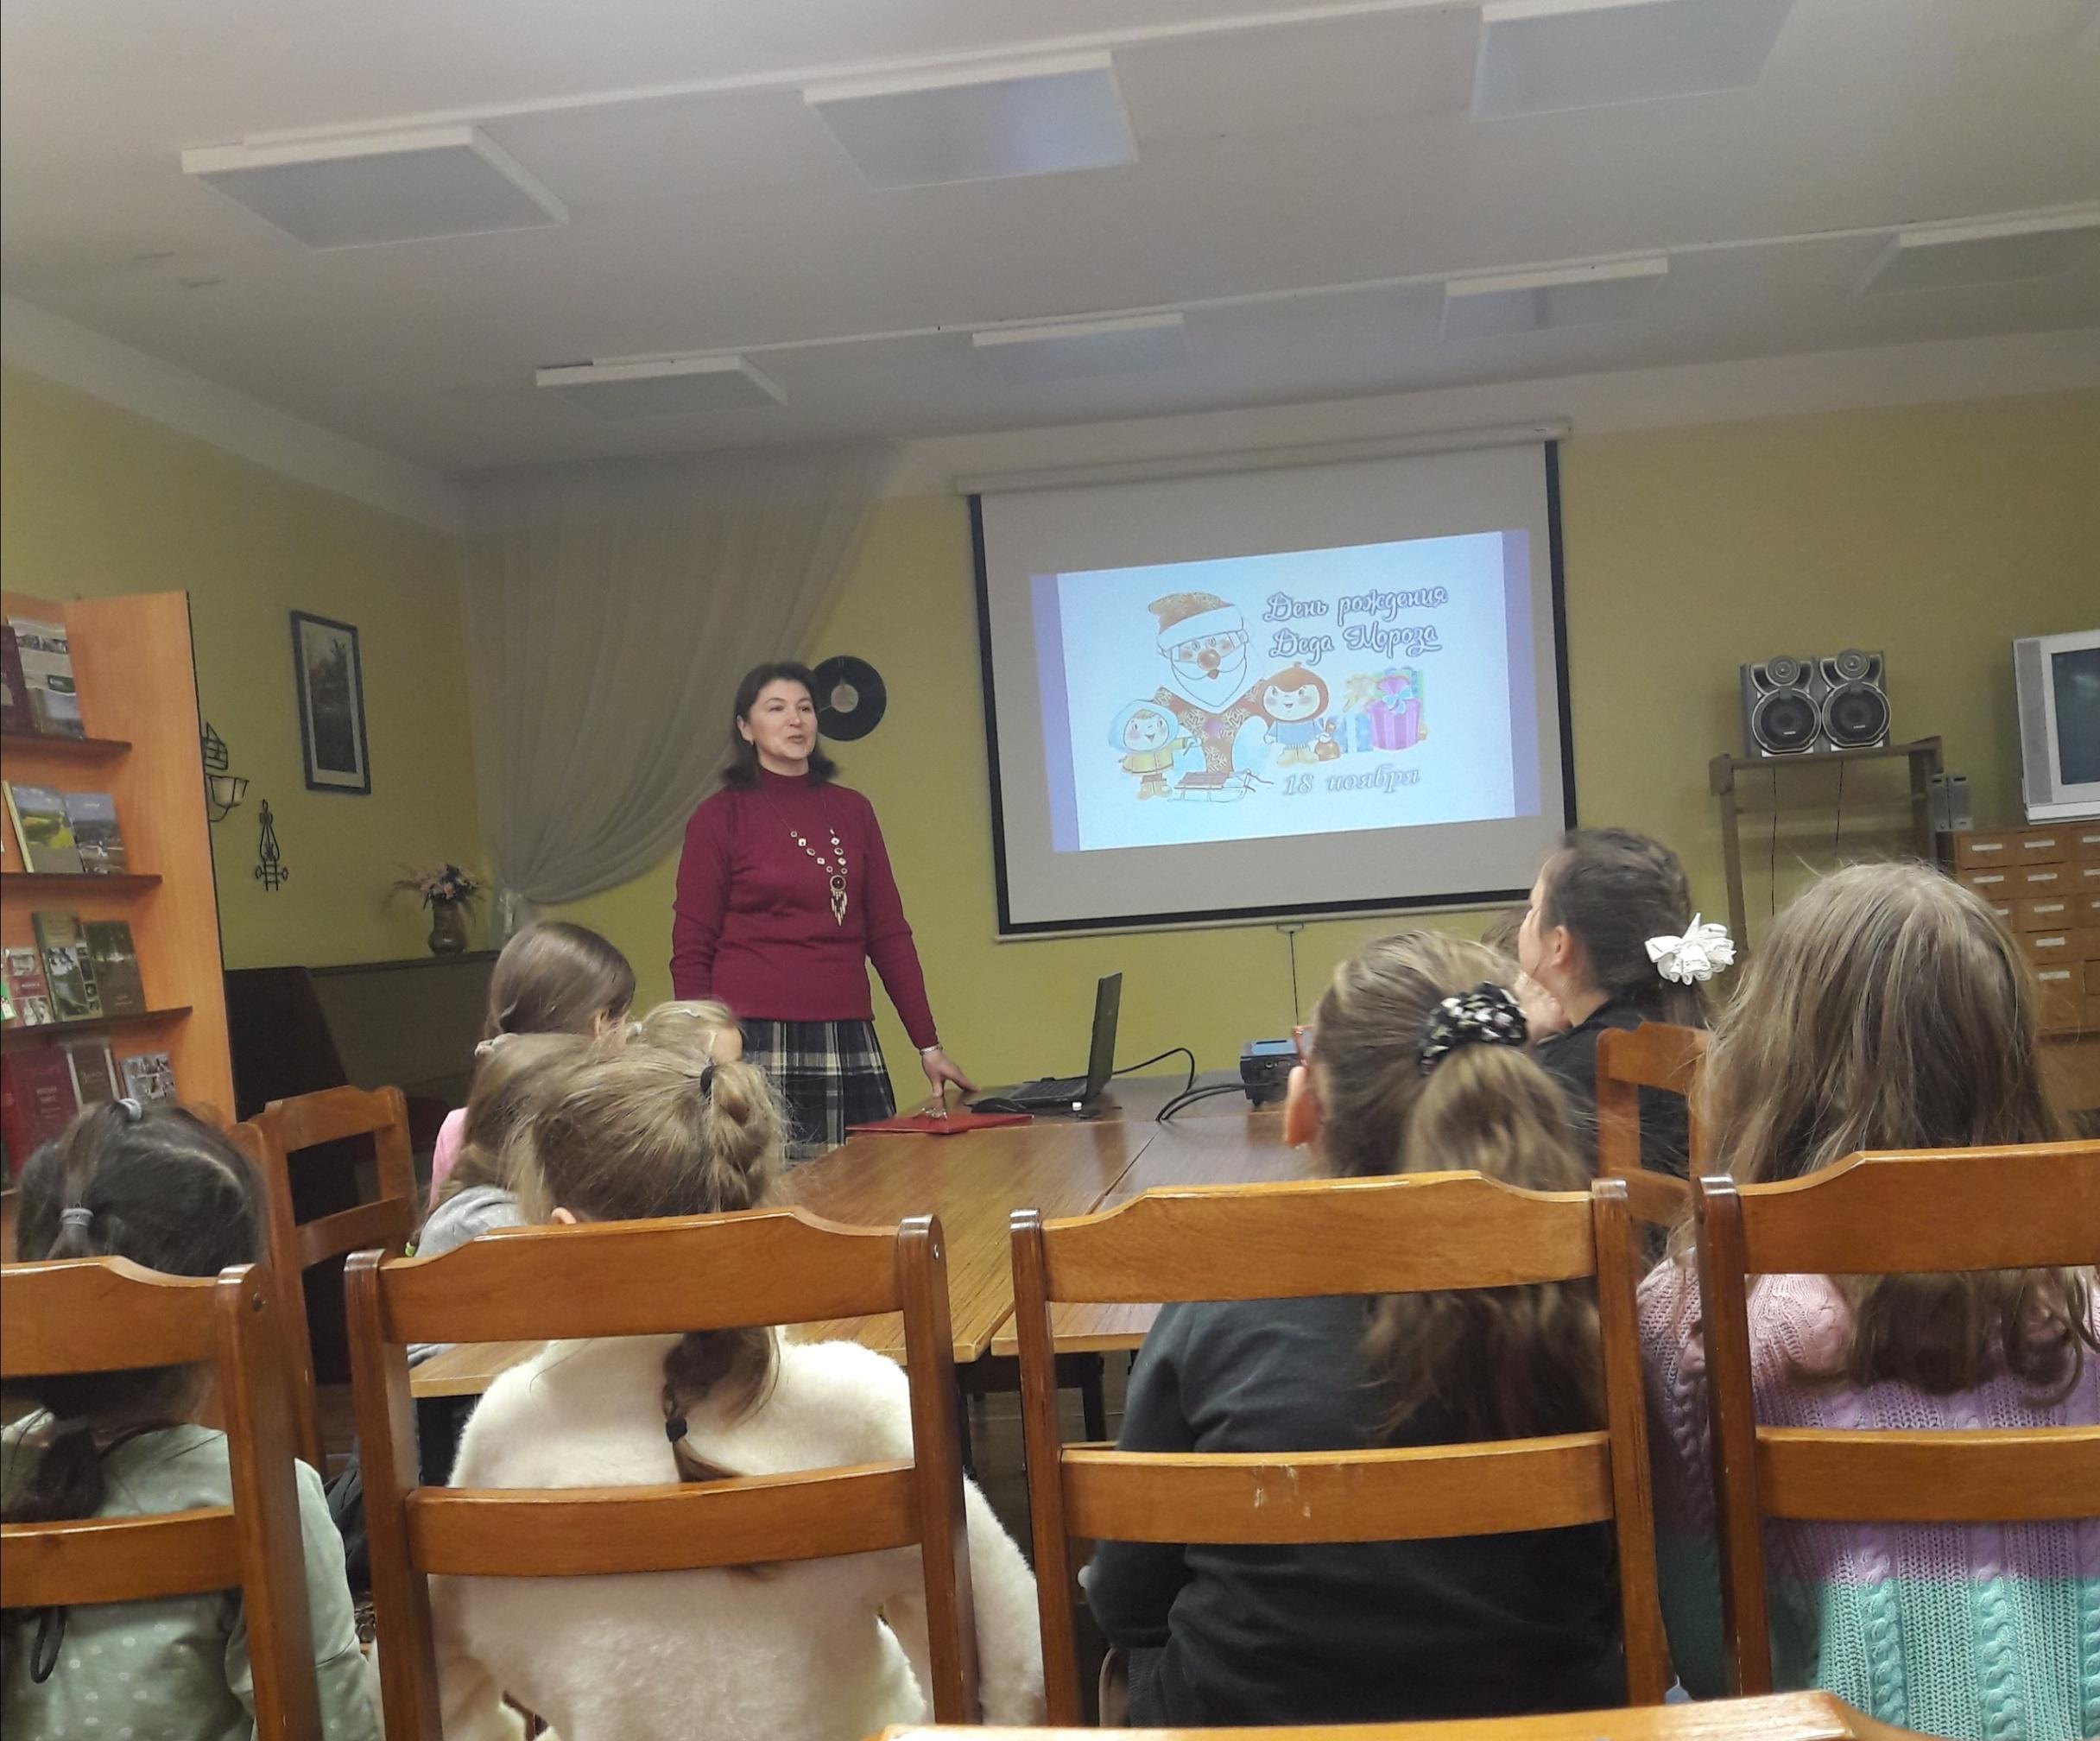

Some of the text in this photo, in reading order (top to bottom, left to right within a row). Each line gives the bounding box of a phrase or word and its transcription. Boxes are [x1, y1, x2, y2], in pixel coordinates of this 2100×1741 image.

[1262, 586, 1449, 627] День рождения
[1268, 620, 1444, 666] Деда Мороза
[1281, 763, 1420, 796] 18 ноября
